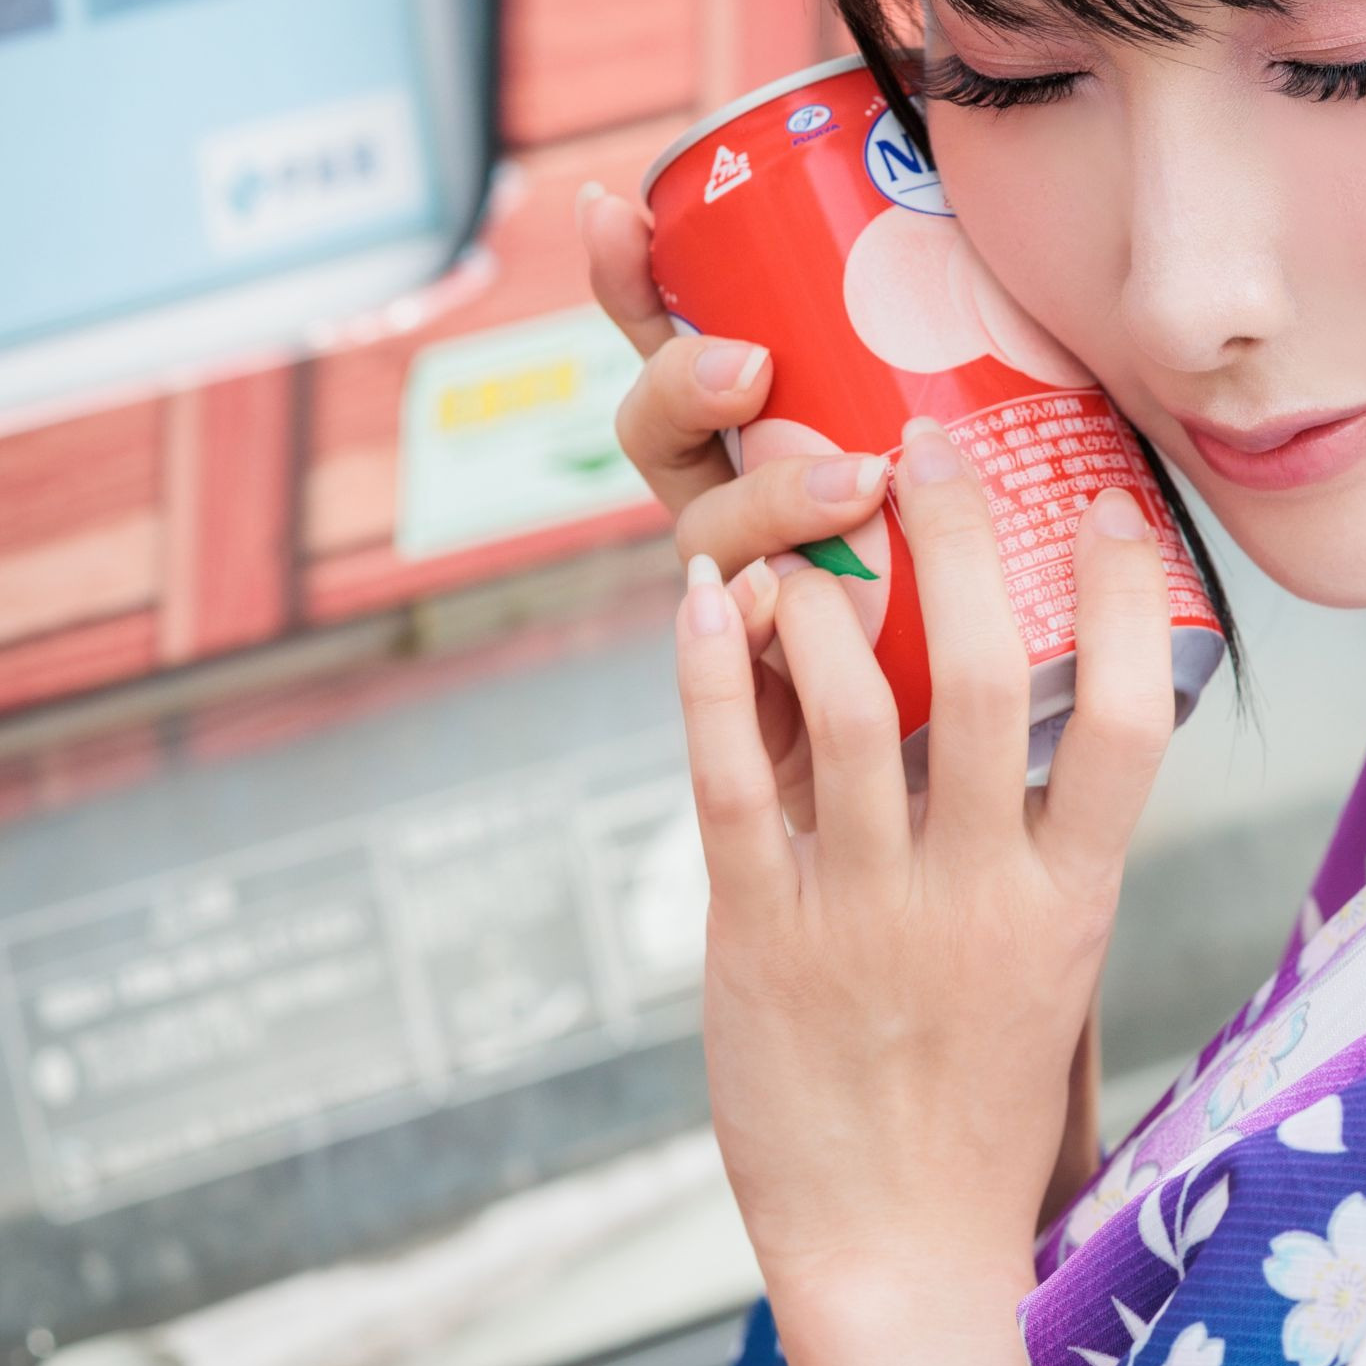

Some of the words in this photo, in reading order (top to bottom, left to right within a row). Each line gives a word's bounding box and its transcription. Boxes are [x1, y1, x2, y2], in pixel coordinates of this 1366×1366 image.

[875, 132, 937, 181] N
[993, 493, 1090, 535] 式会社不二家
